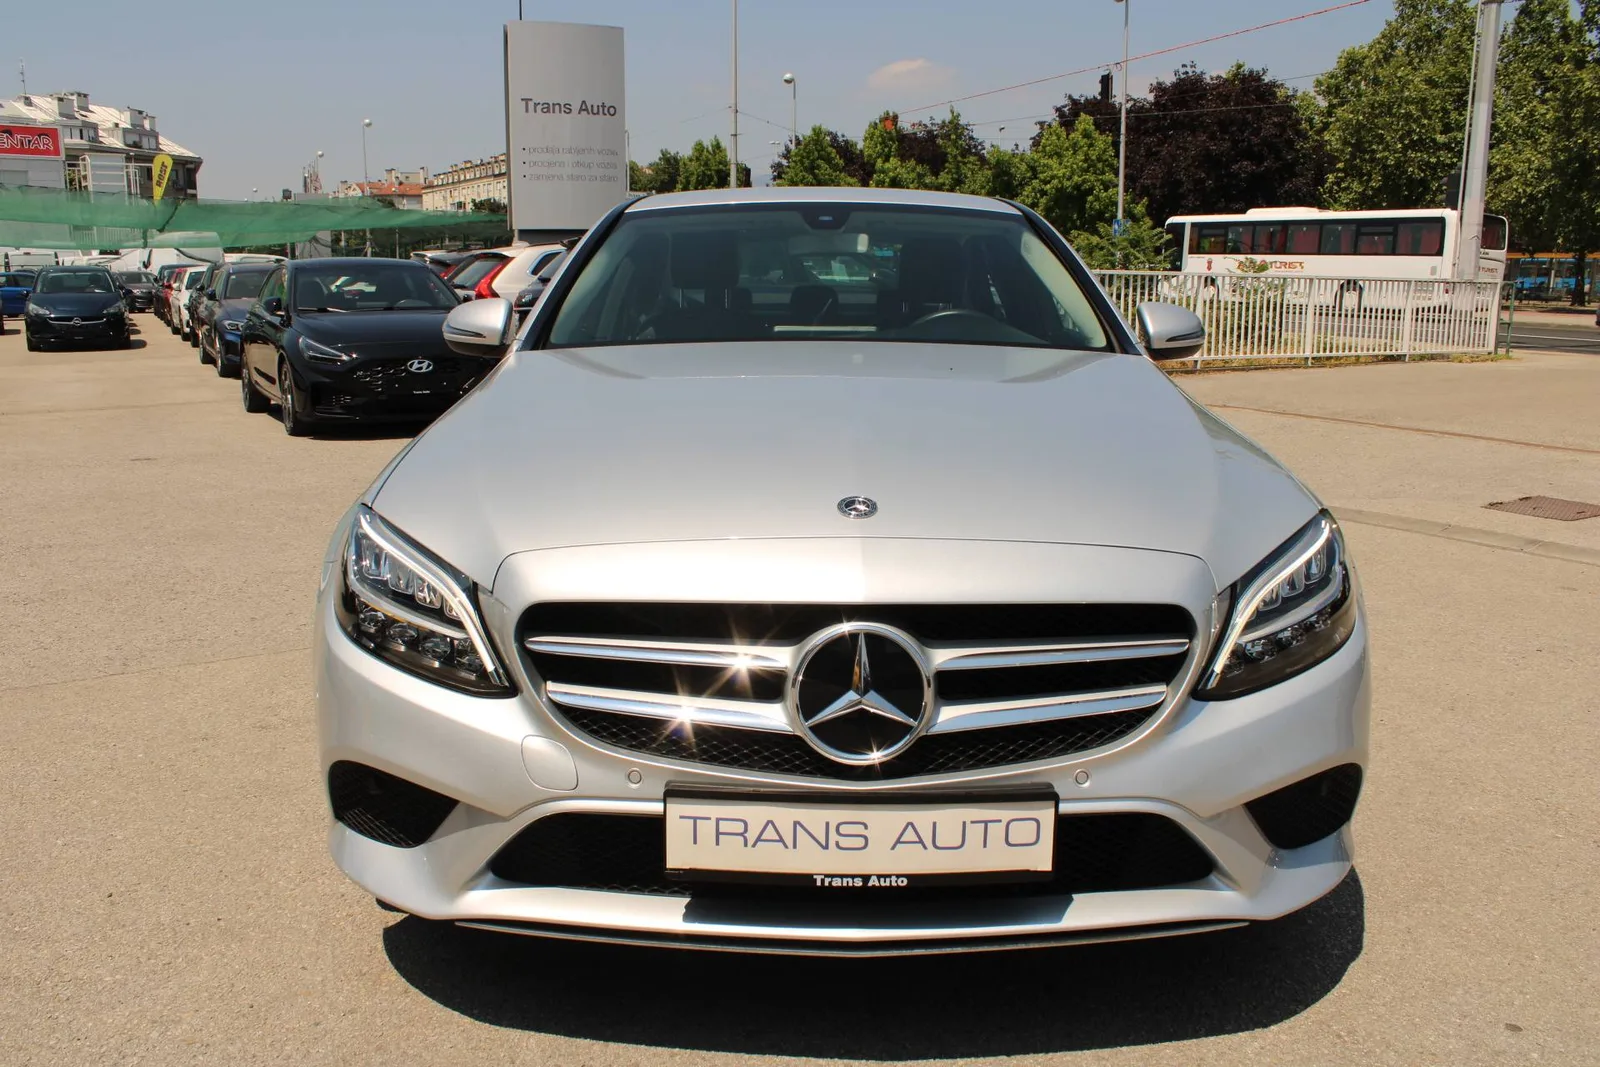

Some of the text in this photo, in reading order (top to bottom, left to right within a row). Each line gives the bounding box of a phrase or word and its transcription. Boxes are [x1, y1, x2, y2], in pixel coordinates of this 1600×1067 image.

[520, 98, 617, 116] Trans Auto
[528, 145, 560, 156] prodaja
[562, 145, 595, 156] rabljenih
[528, 160, 566, 169] procjena
[571, 159, 595, 169] otkup
[528, 172, 563, 182] zamjena
[565, 173, 587, 181] staro
[679, 814, 1041, 851] TRANS AUTO
[813, 874, 908, 887] Trans Auto
